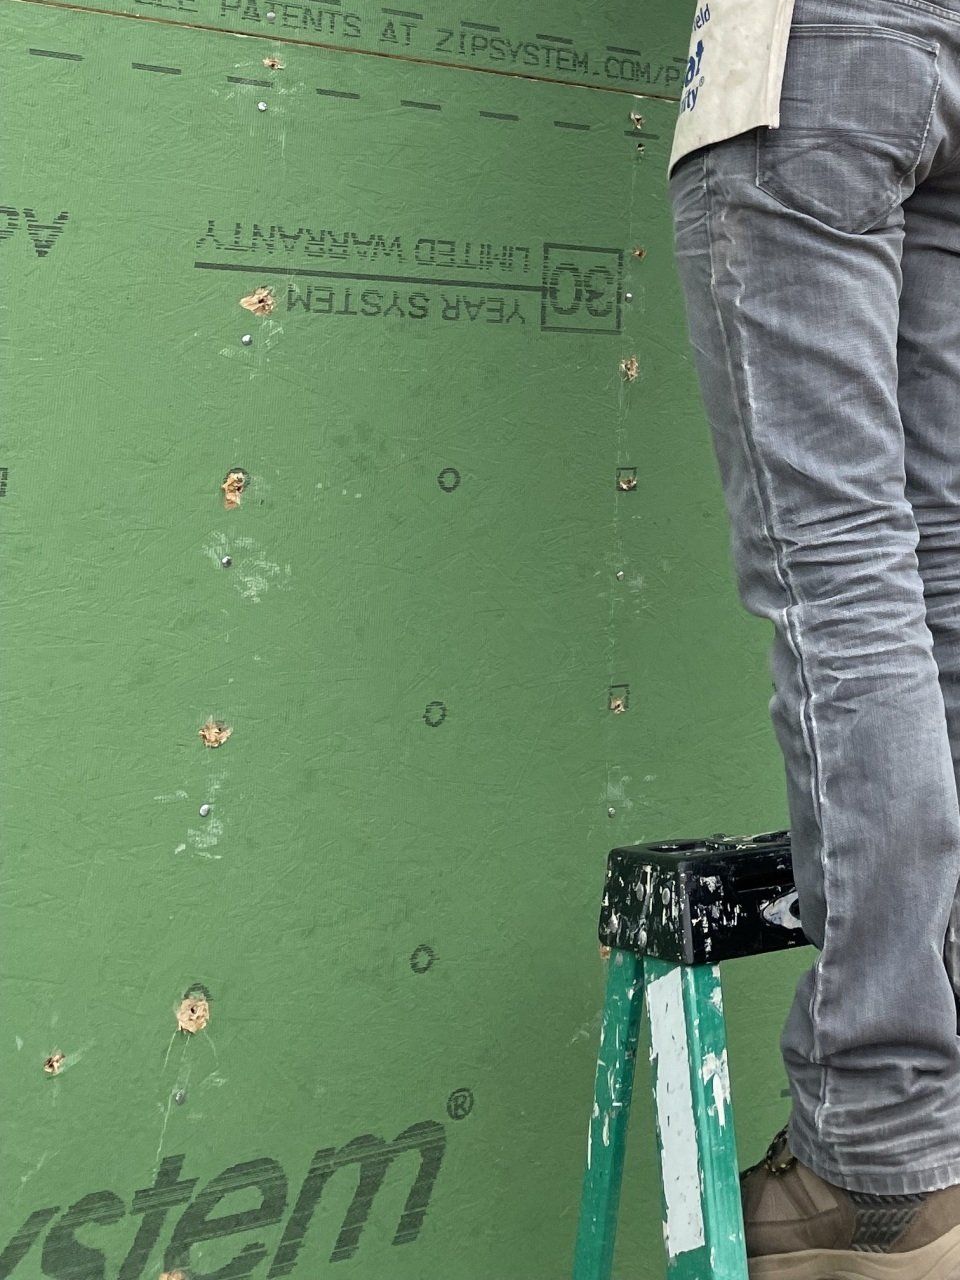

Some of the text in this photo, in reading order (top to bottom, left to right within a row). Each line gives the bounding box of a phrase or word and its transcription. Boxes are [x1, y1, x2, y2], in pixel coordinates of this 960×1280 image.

[379, 18, 418, 46] AT
[433, 27, 685, 89] ZIPSYSTEM.COM/P
[414, 238, 530, 273] LIMITED
[286, 283, 526, 325] YEAR SYSTEM
[548, 262, 616, 319] 30
